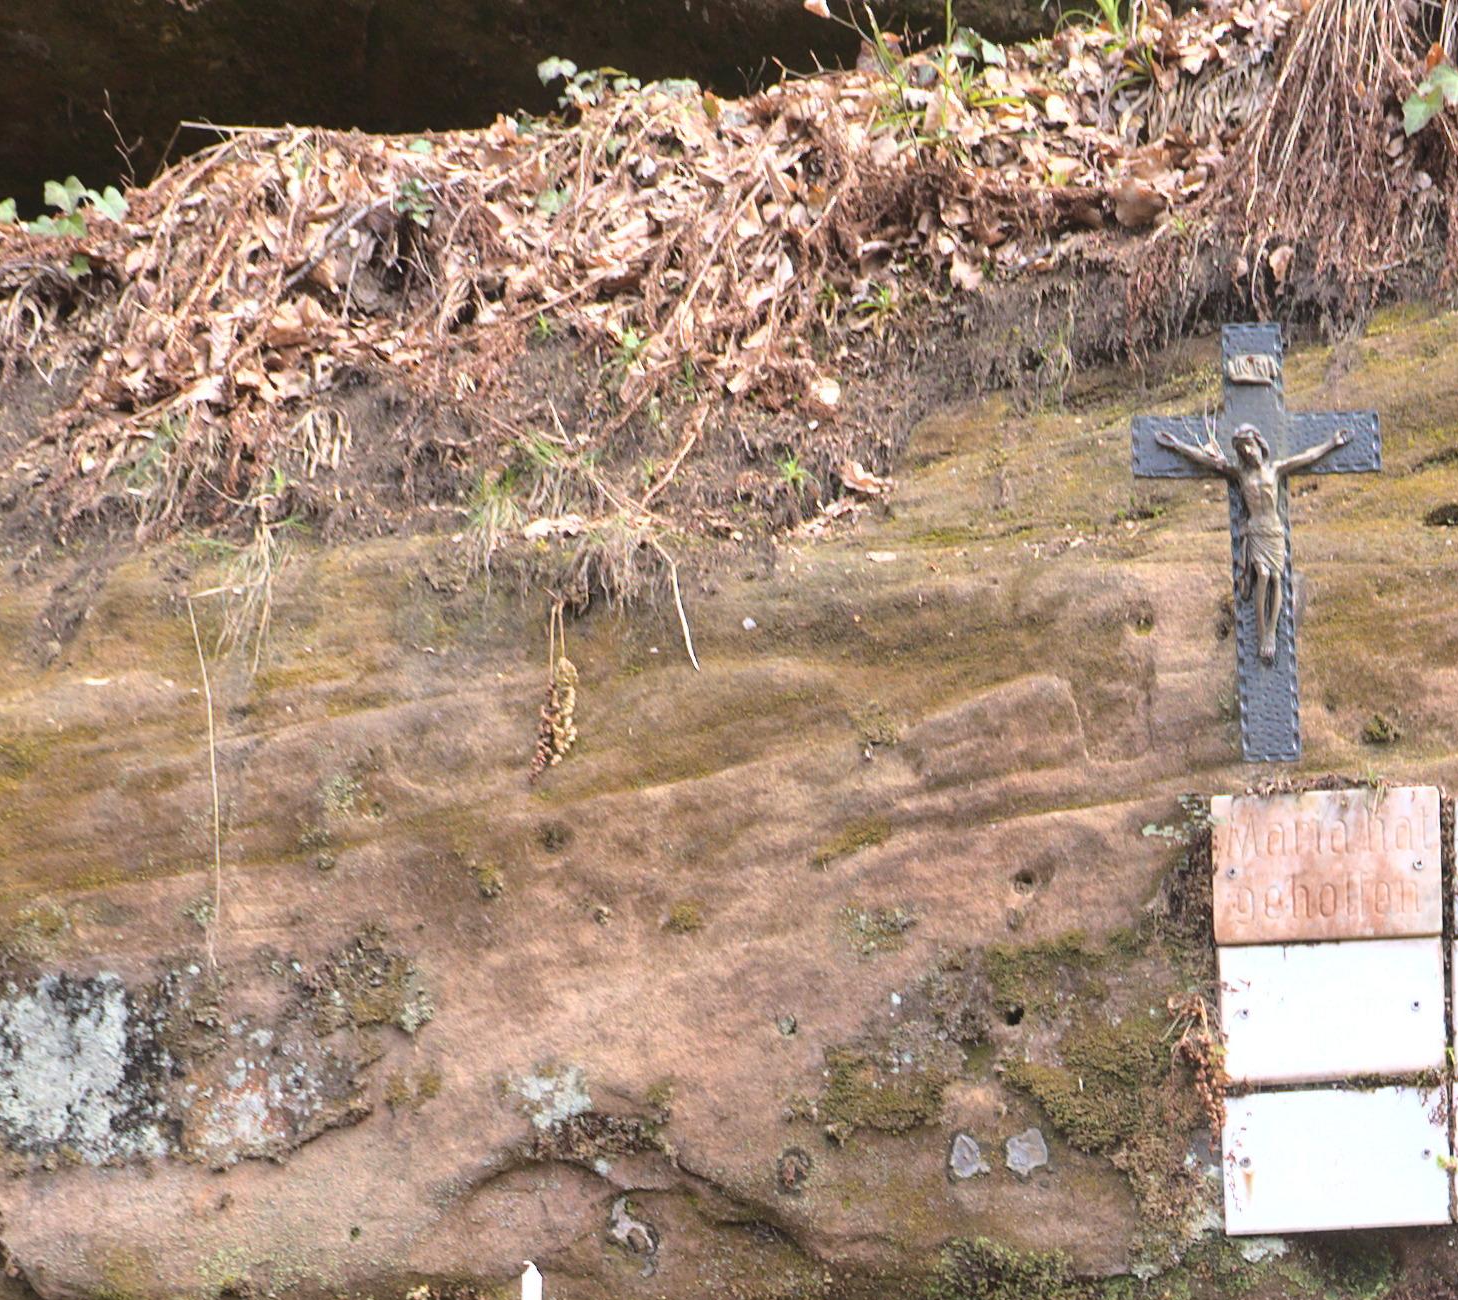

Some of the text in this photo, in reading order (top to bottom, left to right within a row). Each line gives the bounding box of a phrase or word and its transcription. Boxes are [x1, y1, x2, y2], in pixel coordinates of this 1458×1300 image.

[1226, 804, 1430, 860] Maria hat
[1232, 870, 1422, 925] geholfen
